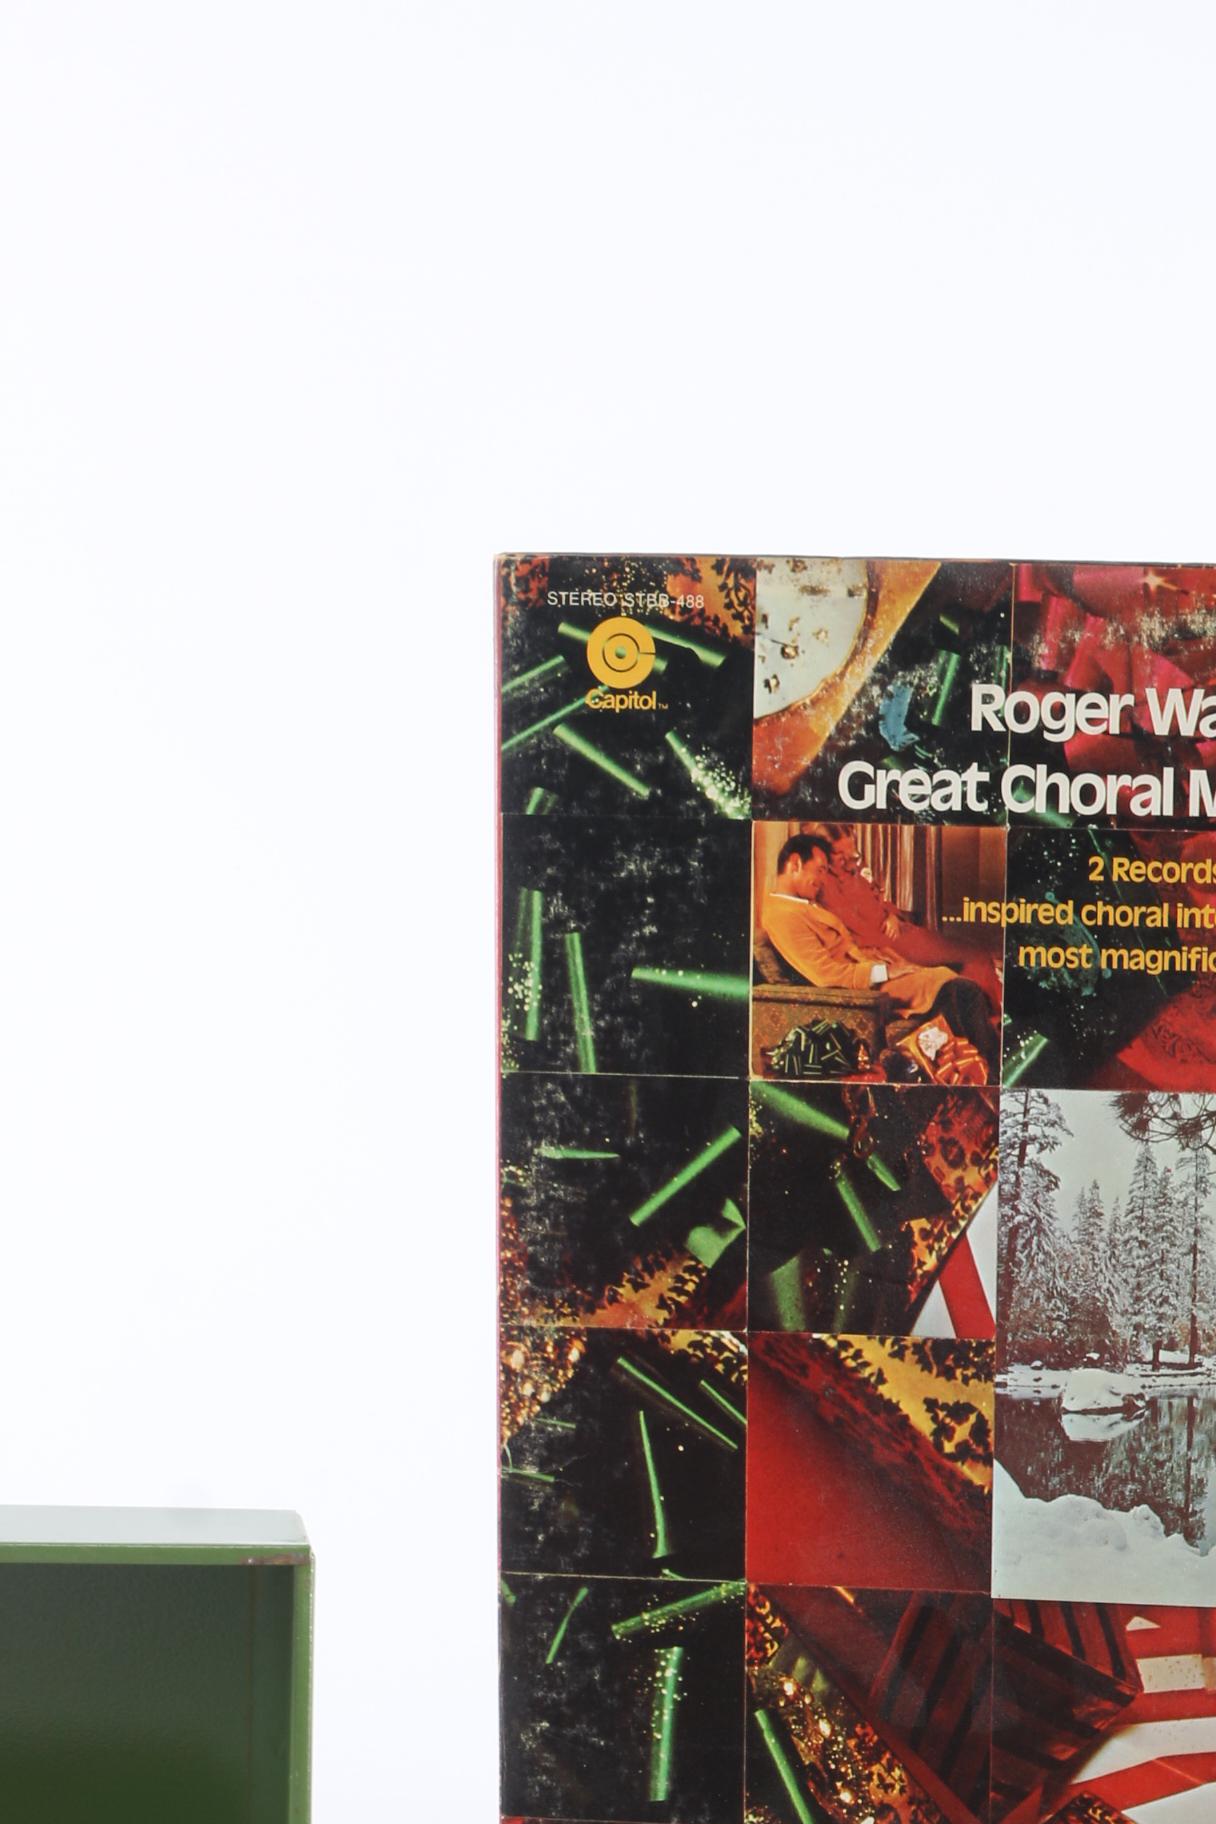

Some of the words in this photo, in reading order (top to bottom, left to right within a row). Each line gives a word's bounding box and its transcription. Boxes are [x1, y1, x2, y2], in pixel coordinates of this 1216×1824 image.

[547, 590, 616, 607] STEREO
[585, 689, 657, 712] Capitol
[970, 683, 1134, 741] Roger
[838, 760, 988, 811] Great
[1000, 763, 1173, 816] Choral
[1089, 857, 1104, 882] 2
[941, 898, 1072, 936] ...inspired
[1080, 900, 1168, 928] choral
[1018, 945, 1091, 970] most
